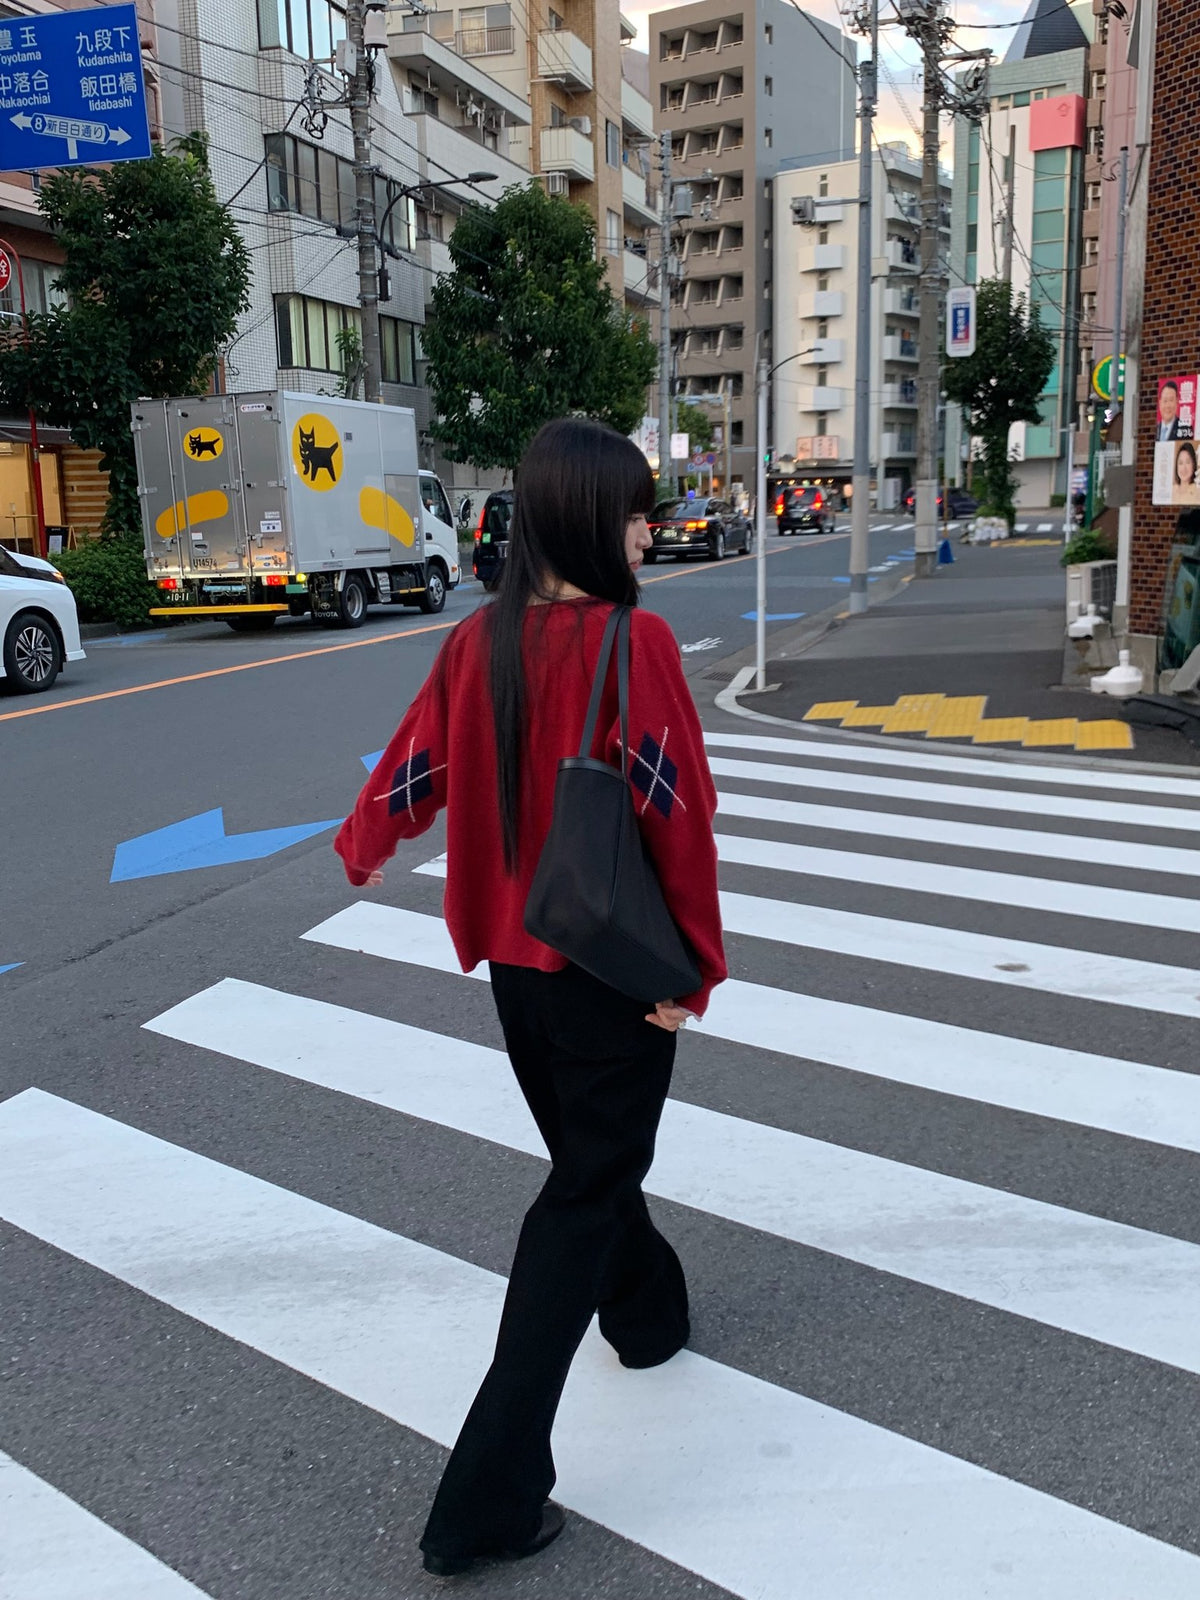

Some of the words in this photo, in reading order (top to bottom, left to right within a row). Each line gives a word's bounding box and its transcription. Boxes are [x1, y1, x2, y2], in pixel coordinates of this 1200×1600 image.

[75, 26, 131, 54] 九段下
[0, 51, 42, 66] oyotama
[78, 51, 133, 67] Kudanshita
[0, 69, 49, 96] 中落合
[79, 72, 137, 98] 飯田橋
[89, 96, 133, 111] Iidabashi
[34, 117, 43, 130] 8
[46, 119, 103, 139] 新目白通り
